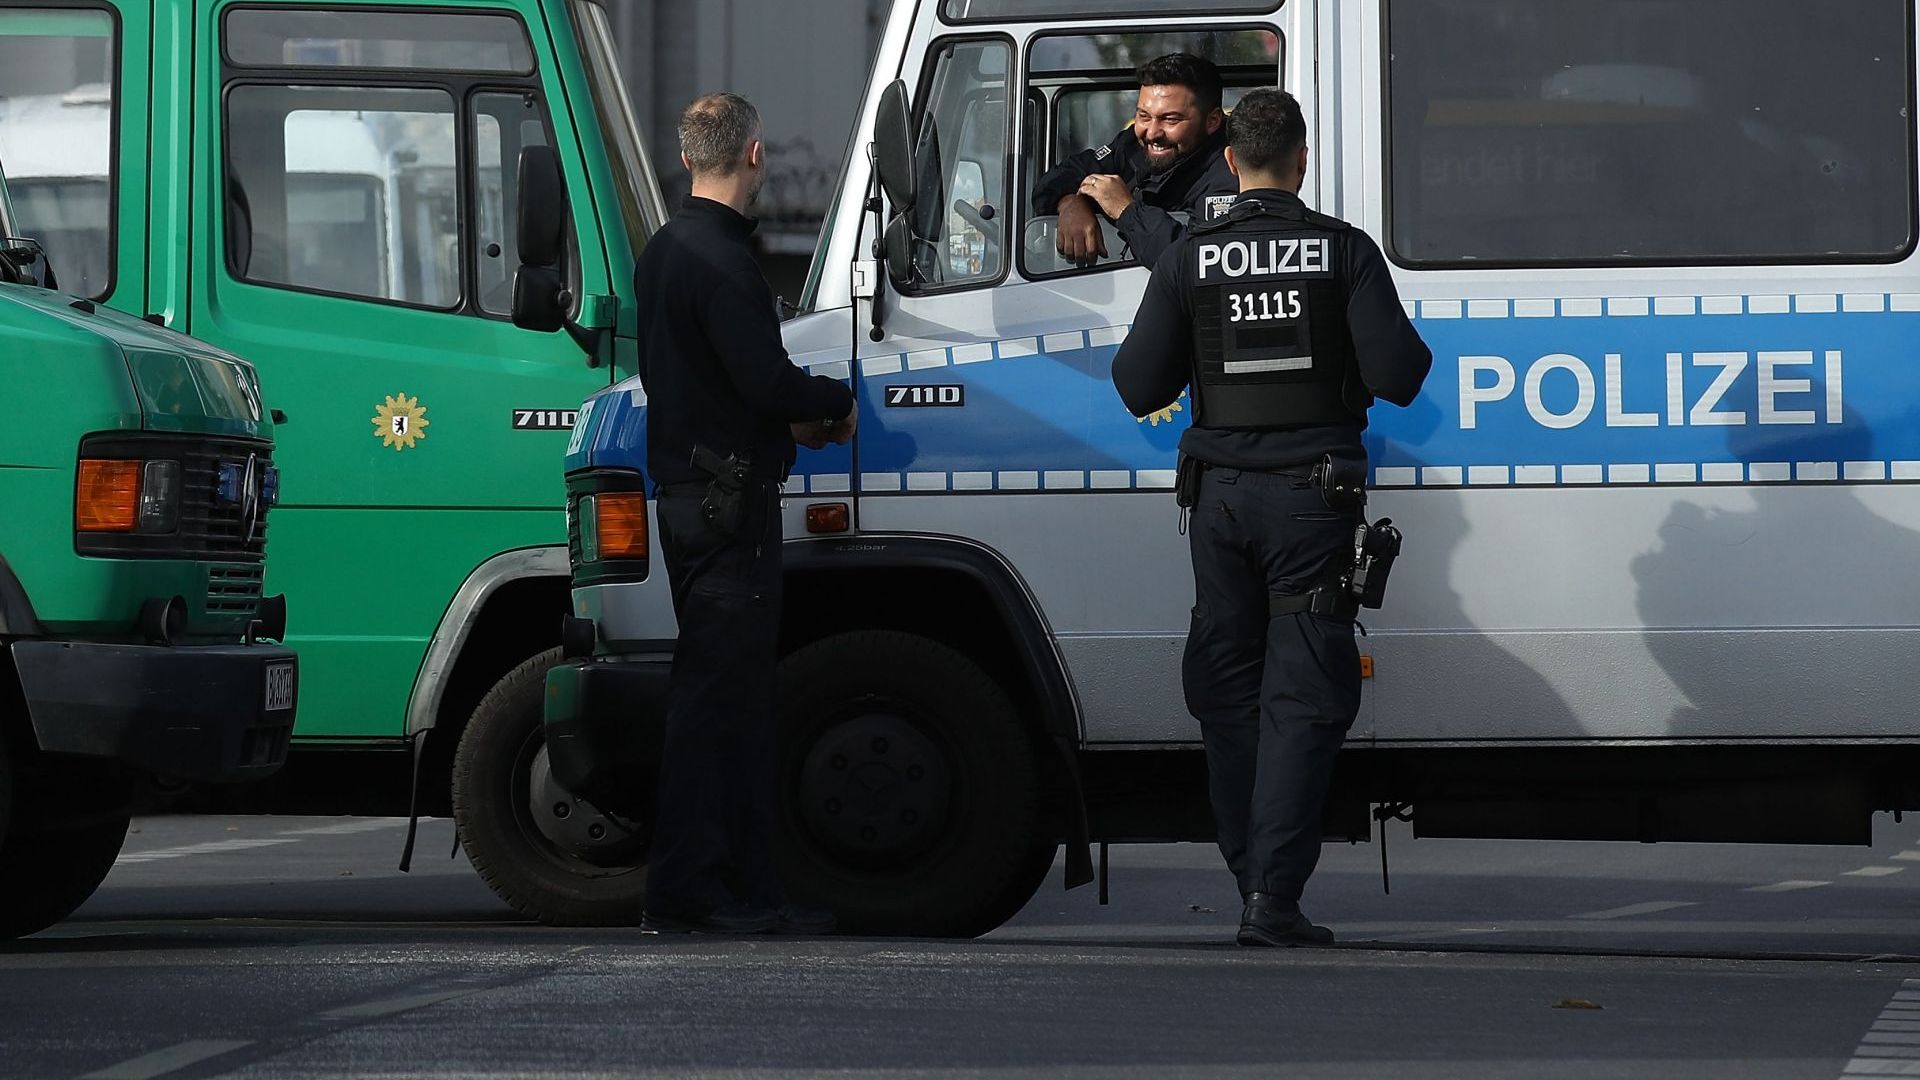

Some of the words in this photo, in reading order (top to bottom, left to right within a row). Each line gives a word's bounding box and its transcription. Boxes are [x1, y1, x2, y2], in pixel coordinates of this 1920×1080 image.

[1199, 239, 1329, 279] POLIZEI
[1229, 290, 1301, 322] 31115
[888, 387, 960, 403] 711D
[1459, 351, 1842, 428] POLIZEI
[515, 411, 578, 426] 711D
